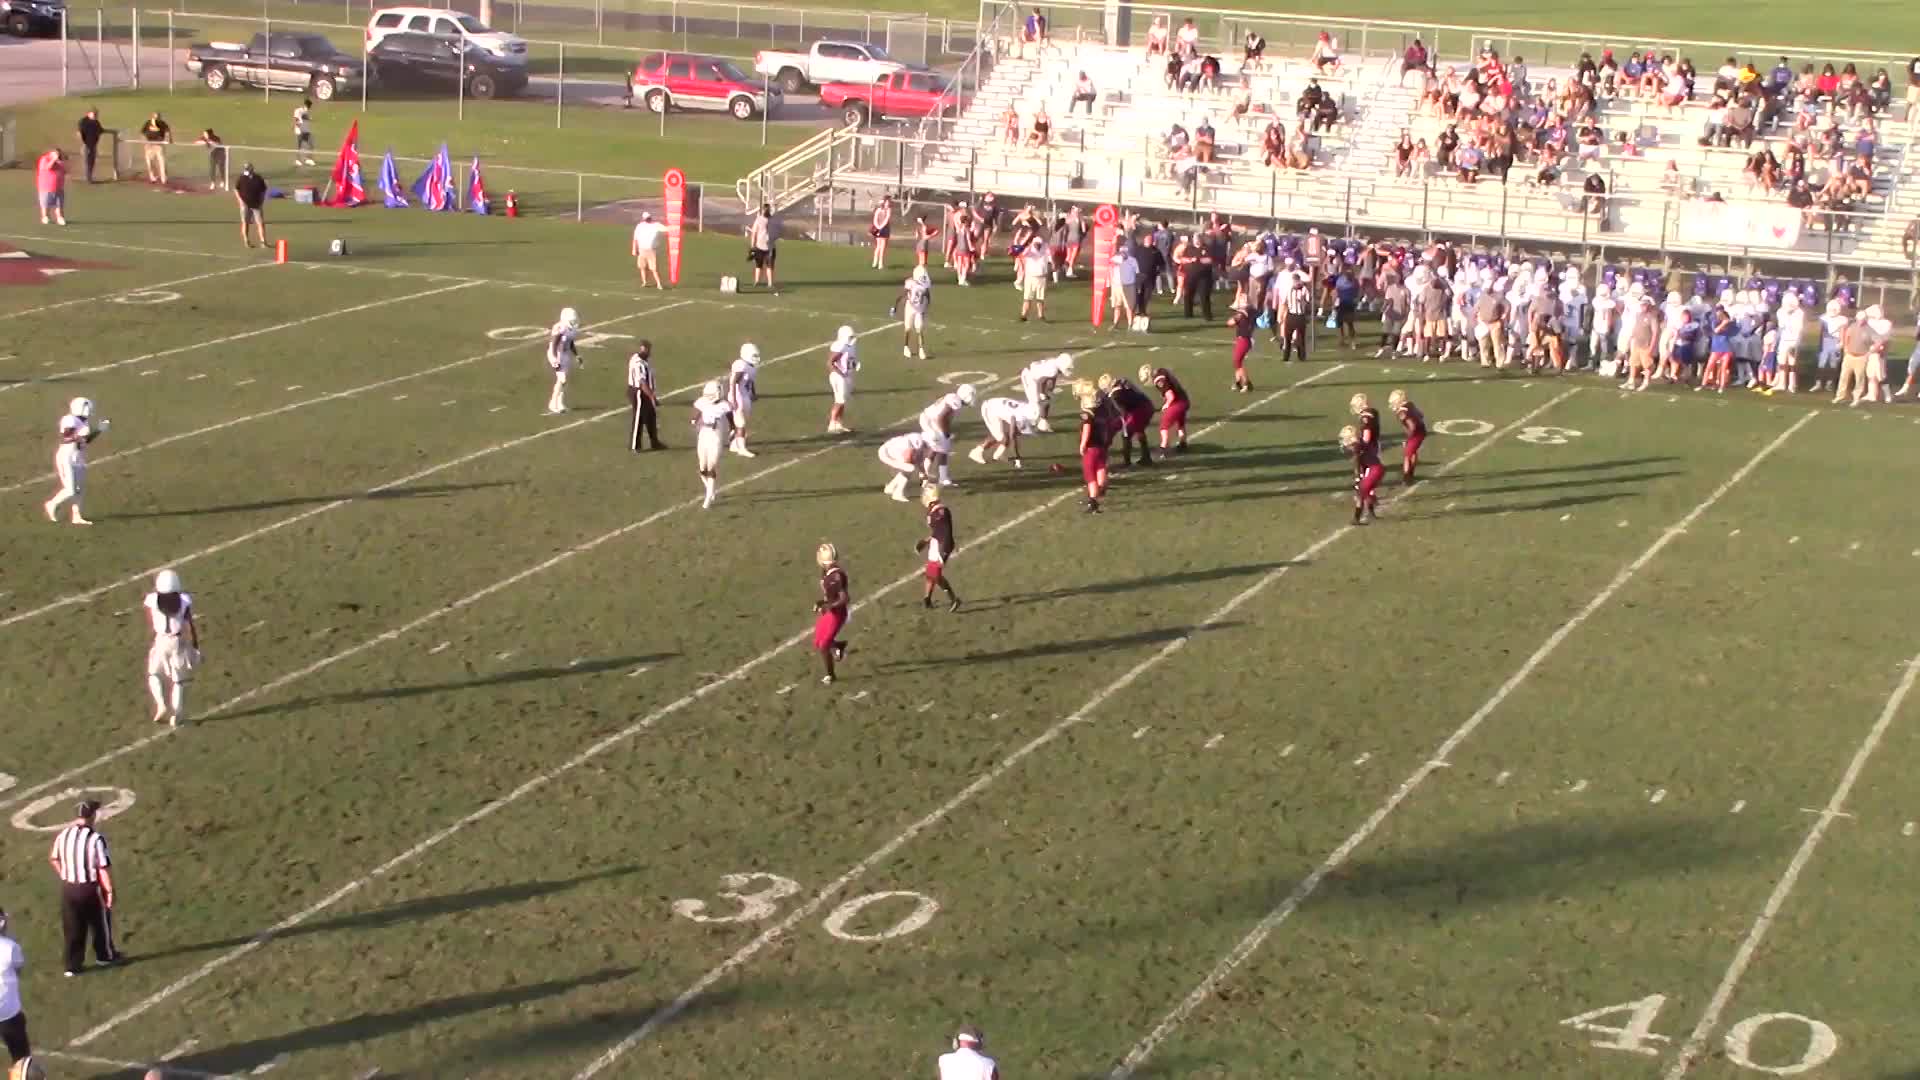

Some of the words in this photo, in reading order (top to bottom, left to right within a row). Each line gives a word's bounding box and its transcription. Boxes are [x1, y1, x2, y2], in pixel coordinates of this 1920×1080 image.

[330, 239, 342, 252] G
[1431, 418, 1584, 444] 30
[0, 772, 137, 832] 0
[672, 872, 940, 941] 30
[1559, 993, 1838, 1076] 40
